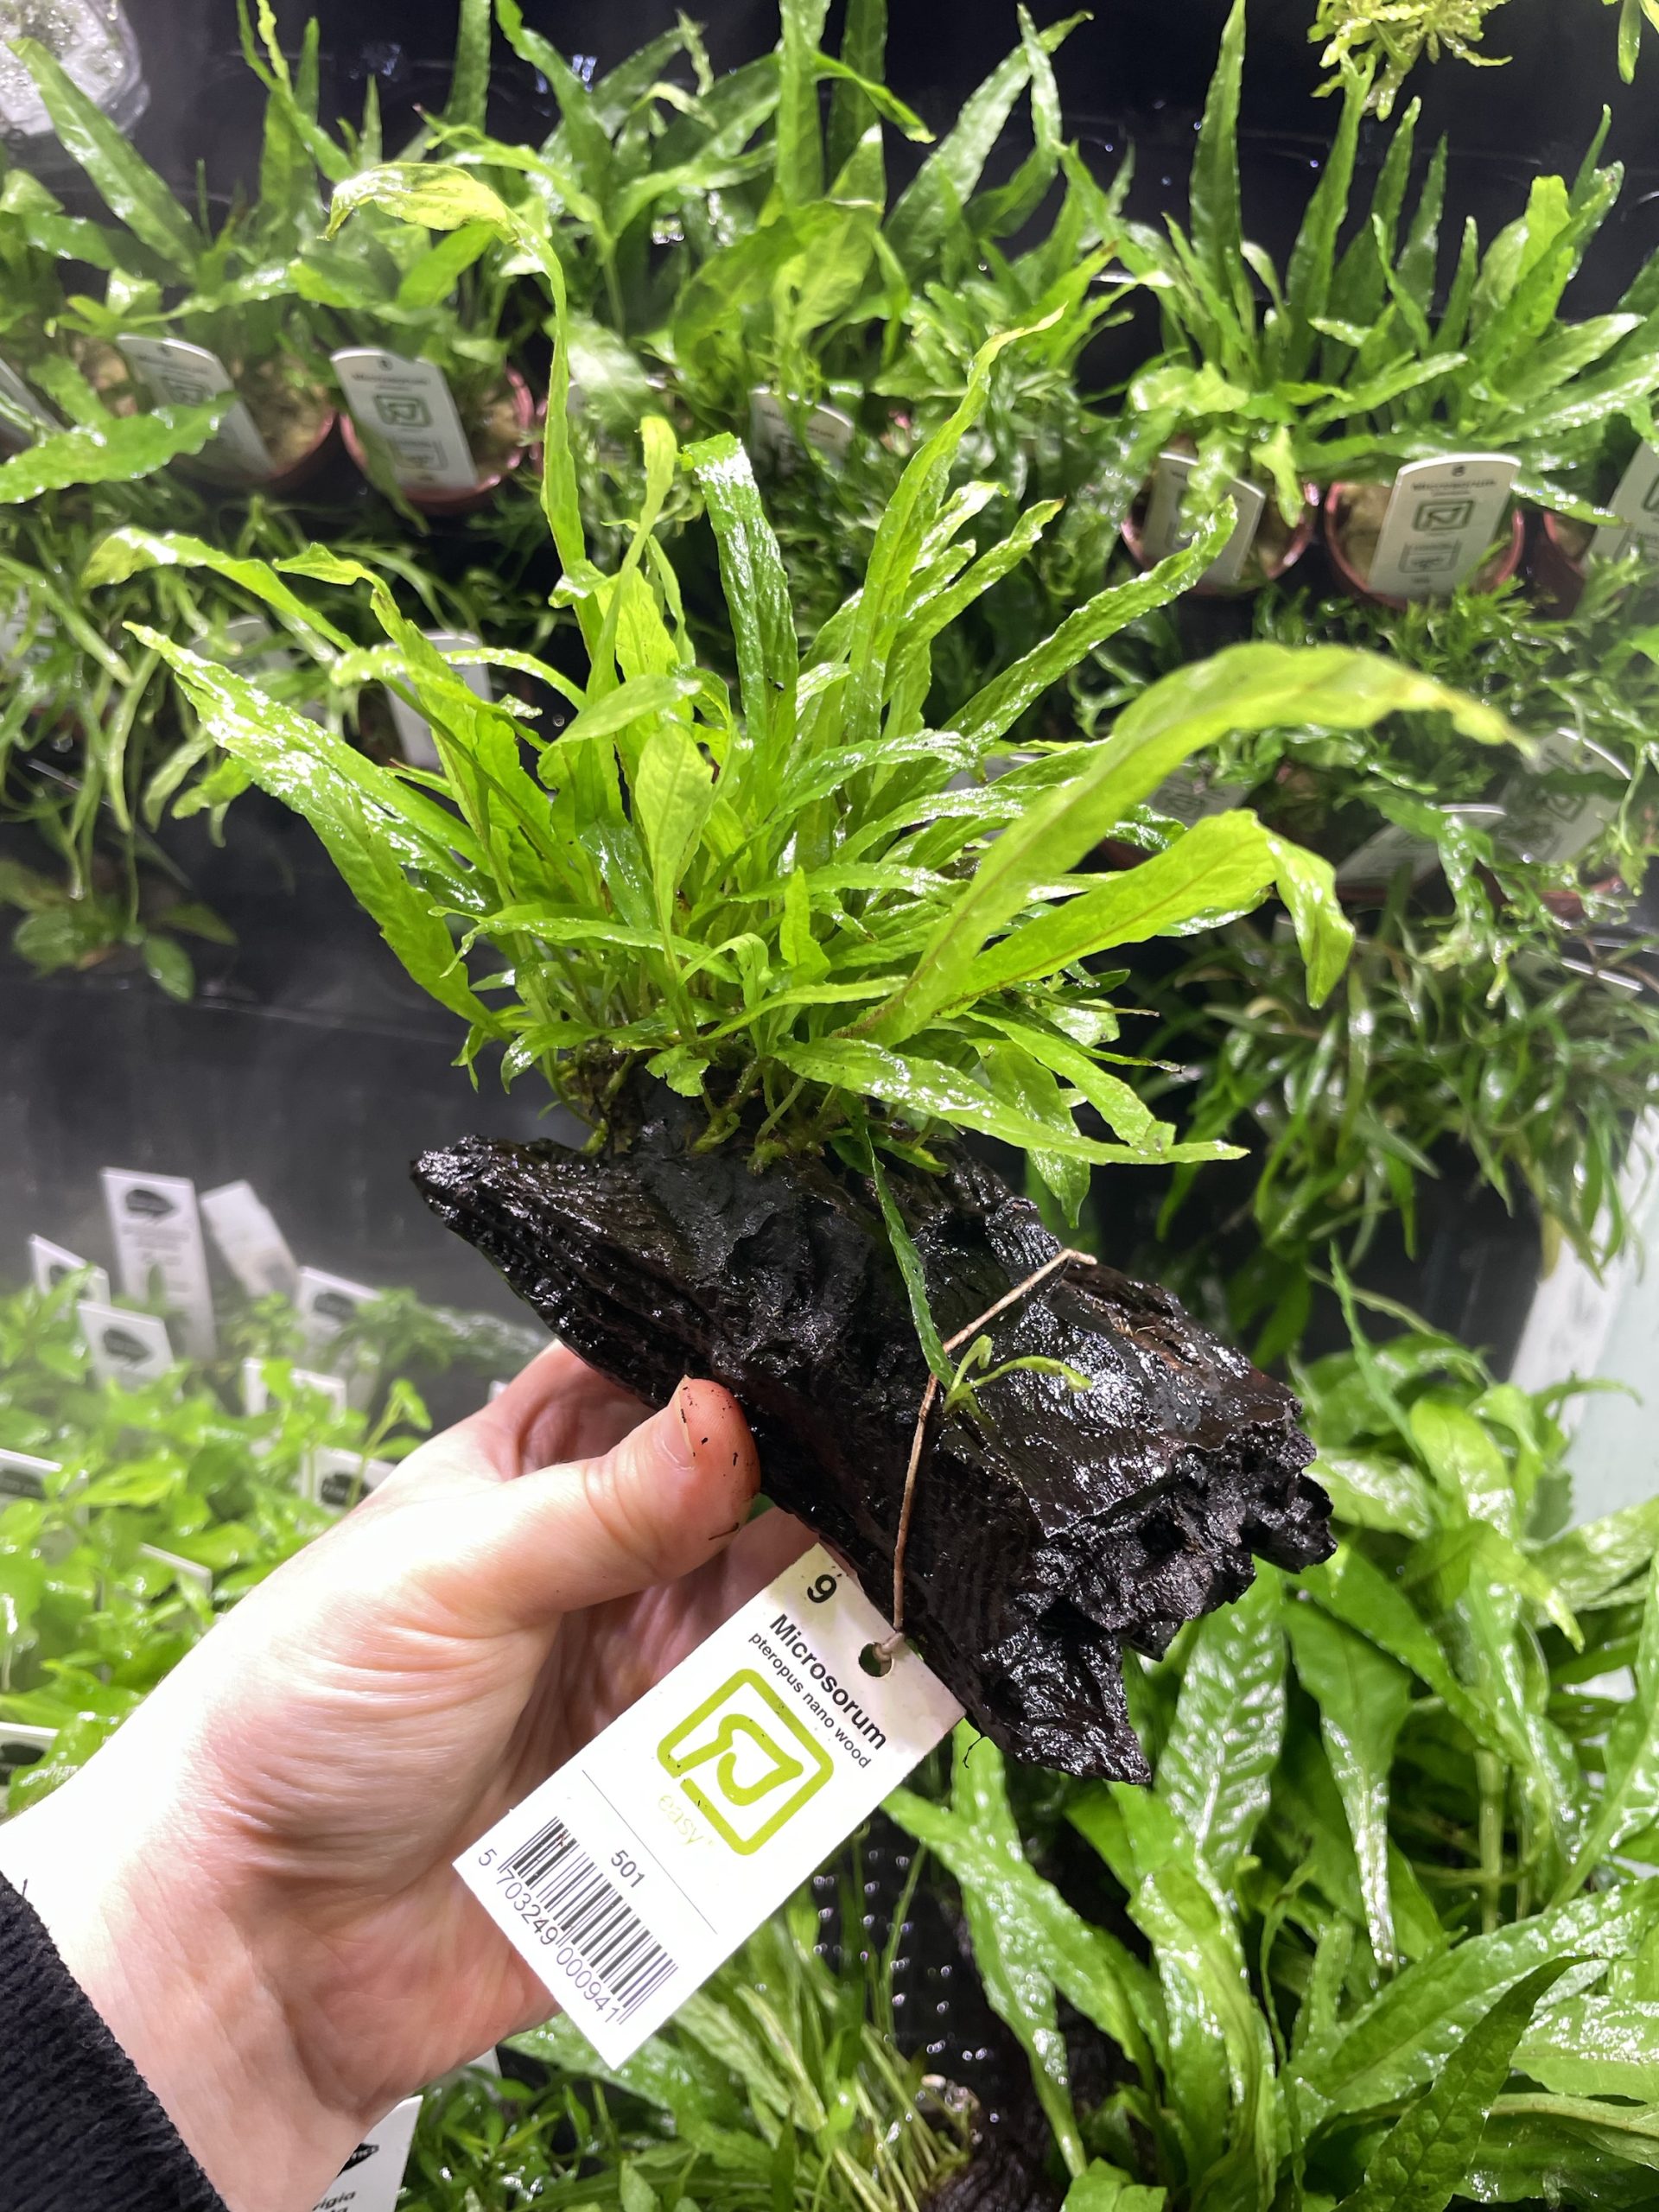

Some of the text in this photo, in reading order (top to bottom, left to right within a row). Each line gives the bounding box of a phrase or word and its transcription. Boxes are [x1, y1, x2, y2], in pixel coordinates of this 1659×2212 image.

[807, 1573, 837, 1604] 9
[748, 1632, 872, 1769] pteropus nano wood
[769, 1613, 887, 1751] Microsorum
[478, 1848, 620, 2023] 5 703249 000941
[610, 1849, 645, 1888] 501
